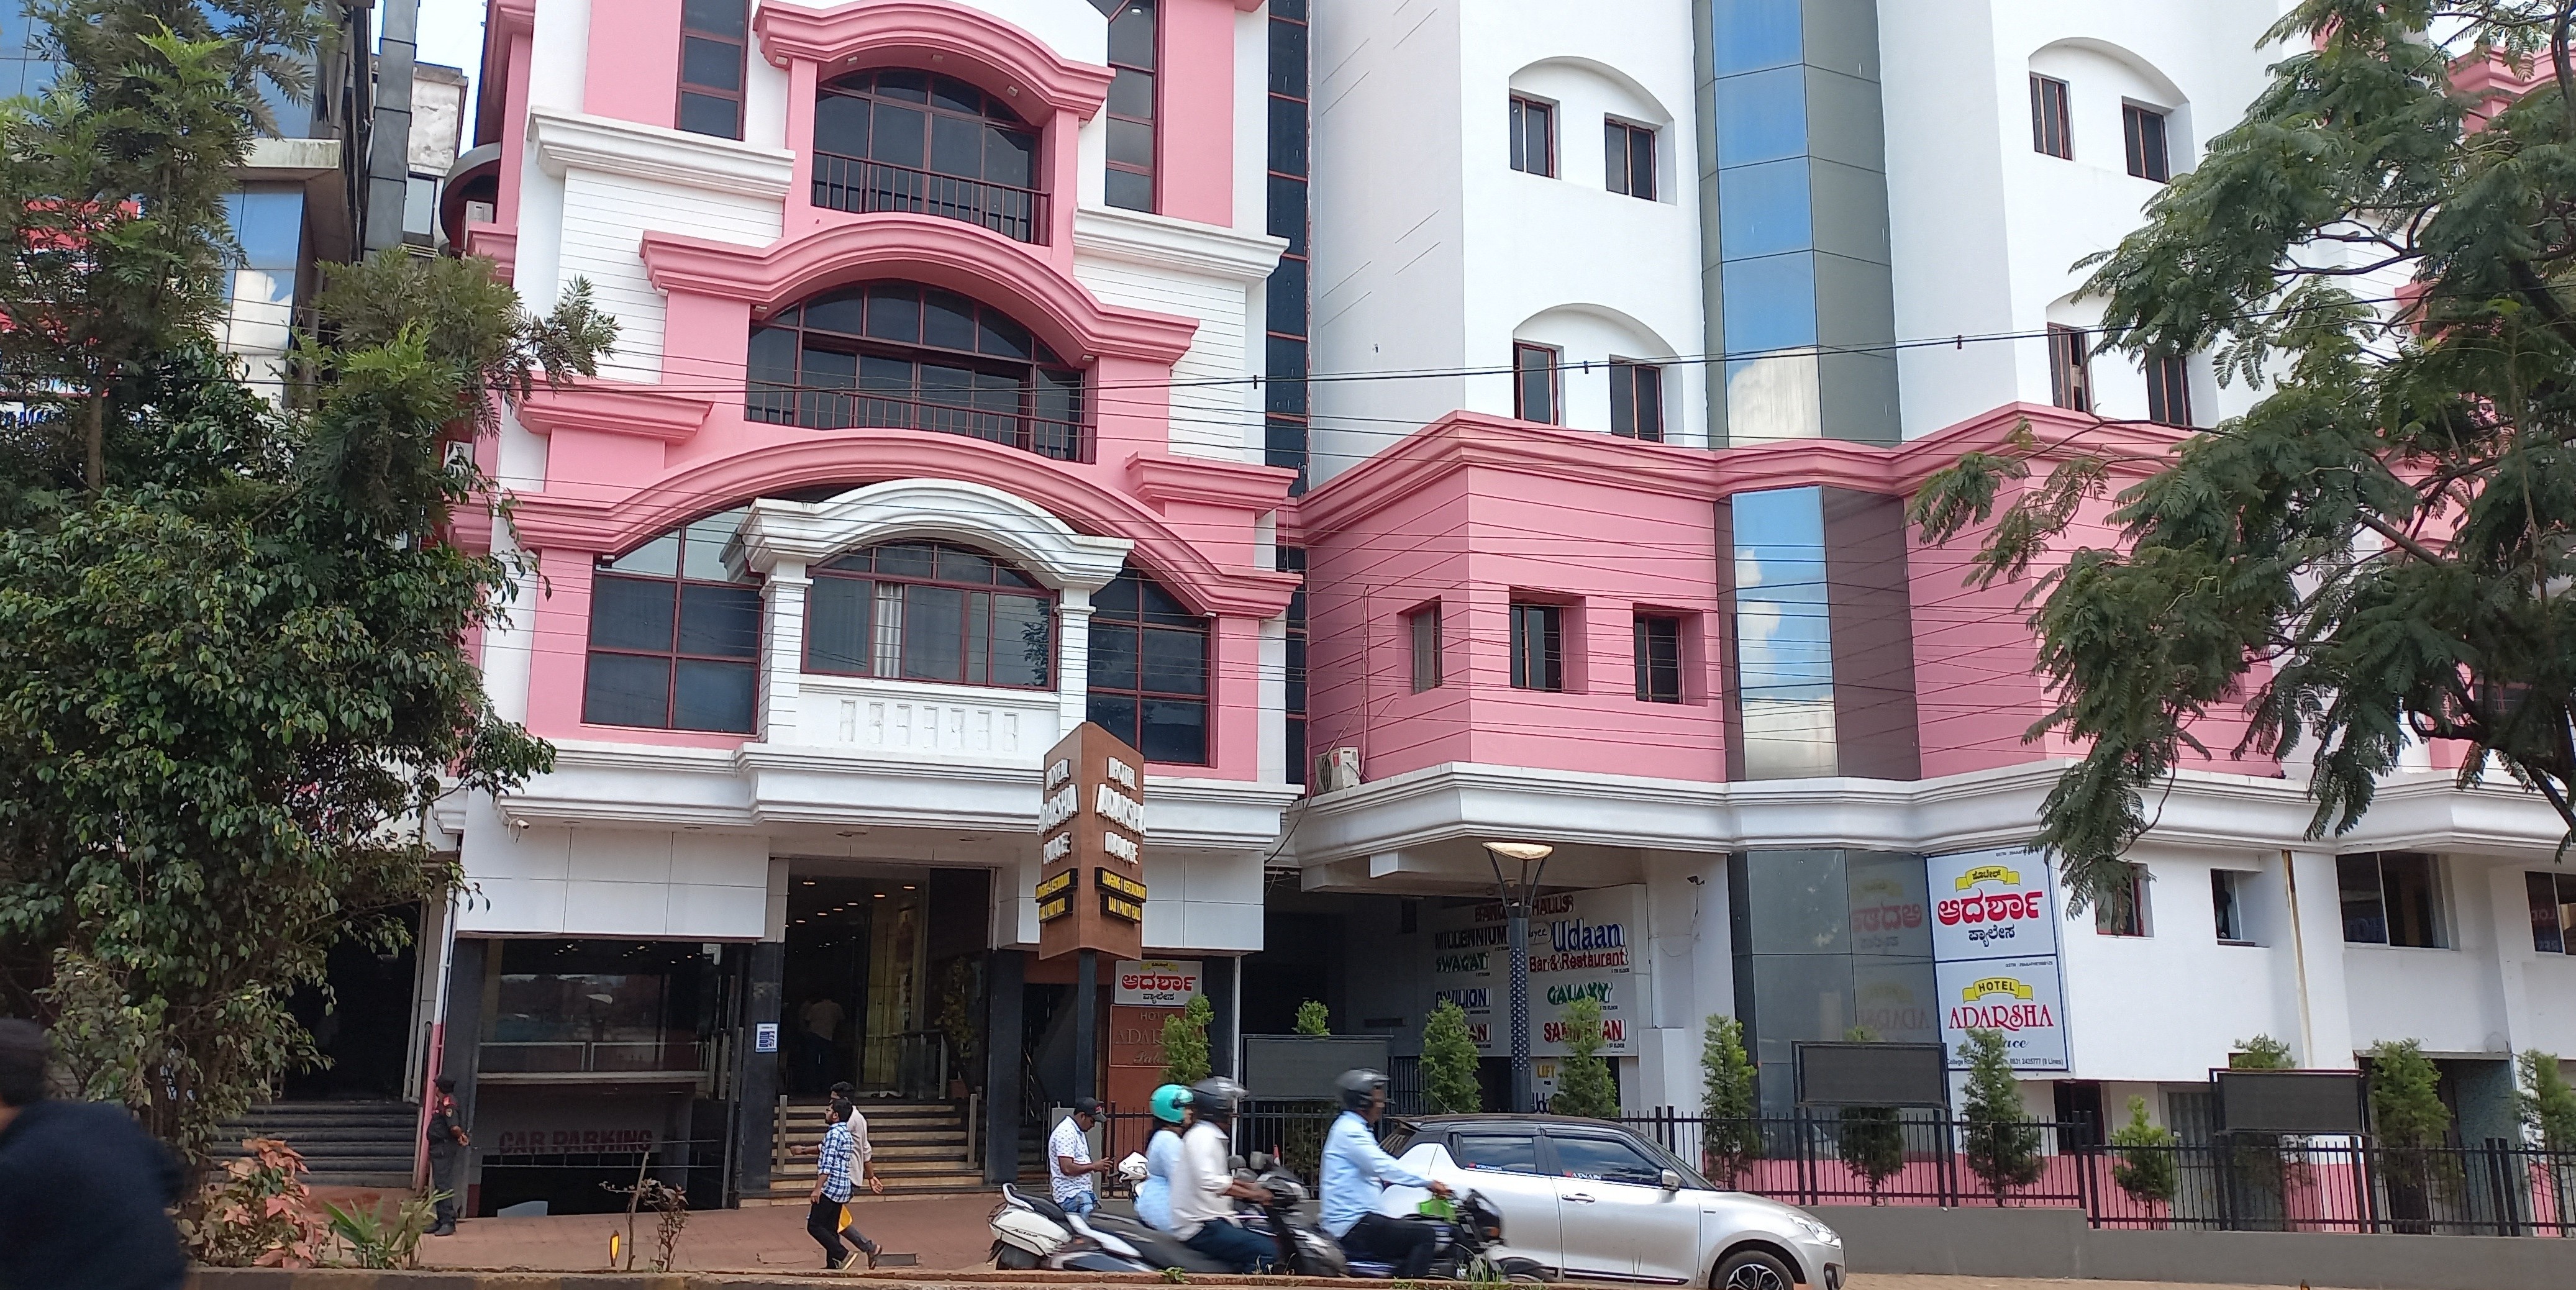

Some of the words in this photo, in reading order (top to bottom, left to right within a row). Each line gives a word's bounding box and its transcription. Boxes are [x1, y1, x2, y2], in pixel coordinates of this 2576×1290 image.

[1435, 925, 1508, 950] MILLENNIUM
[1552, 917, 1626, 952] Udaan
[1529, 956, 1549, 972] Bar
[1550, 954, 1562, 971] &
[1561, 947, 1629, 970] Restaurant
[1978, 981, 2015, 992] HOTEL
[1949, 1004, 2054, 1031] ADARSHA
[499, 1131, 545, 1154] CAR
[552, 1130, 651, 1153] PARKING
